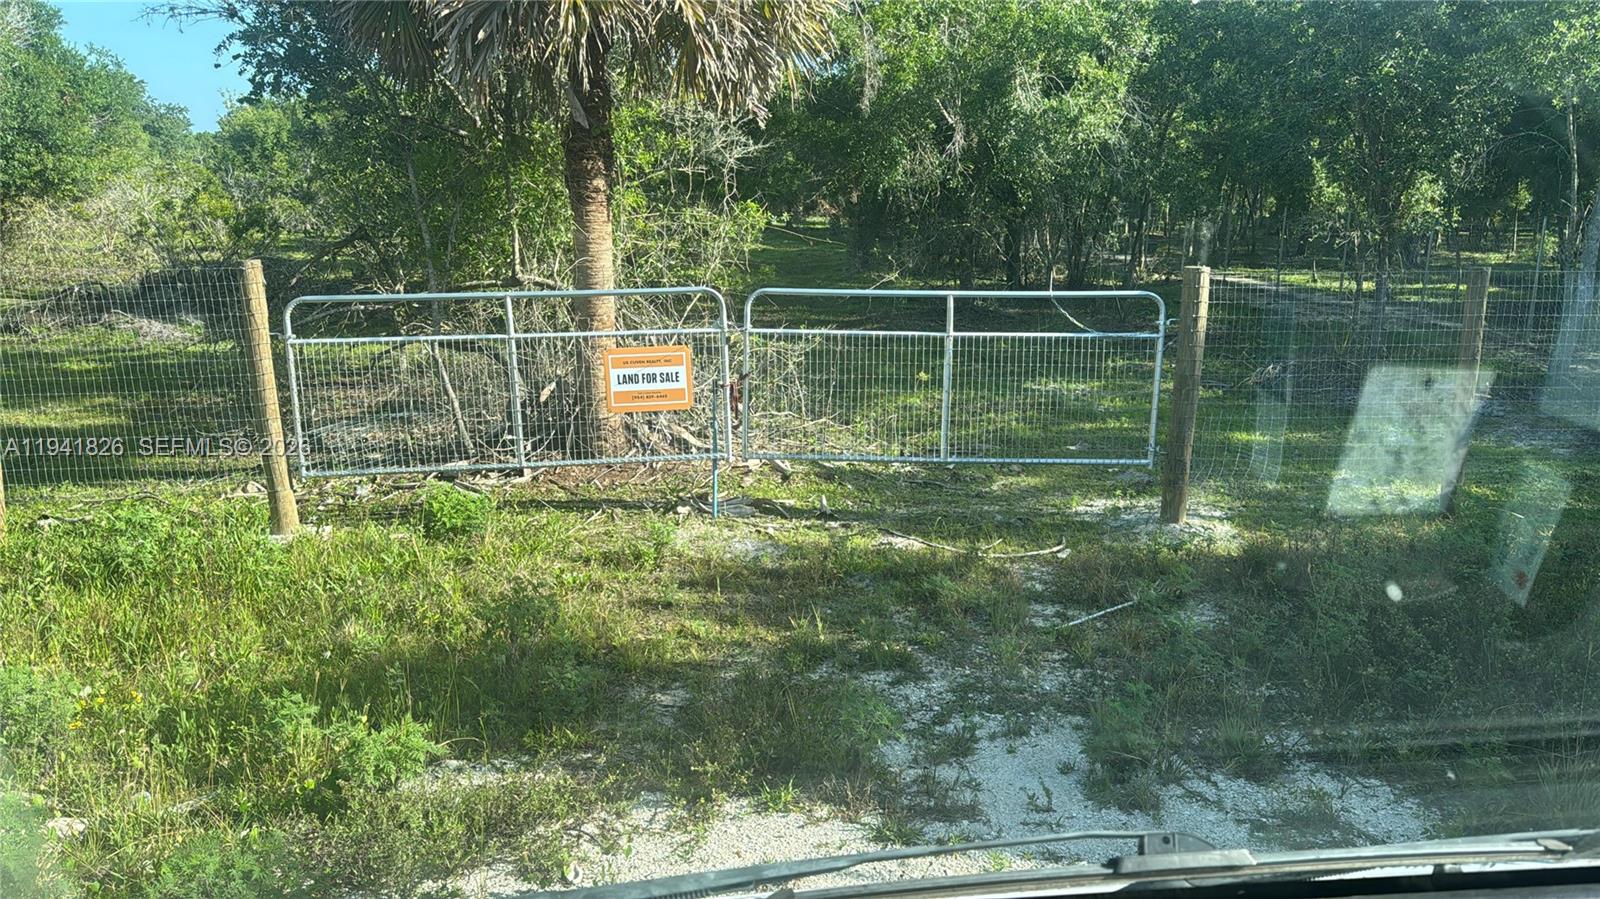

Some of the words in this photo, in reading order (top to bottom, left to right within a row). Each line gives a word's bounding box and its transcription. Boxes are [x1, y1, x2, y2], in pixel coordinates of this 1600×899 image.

[617, 373, 640, 385] LAND
[641, 372, 657, 384] FOR
[659, 371, 680, 383] SALE
